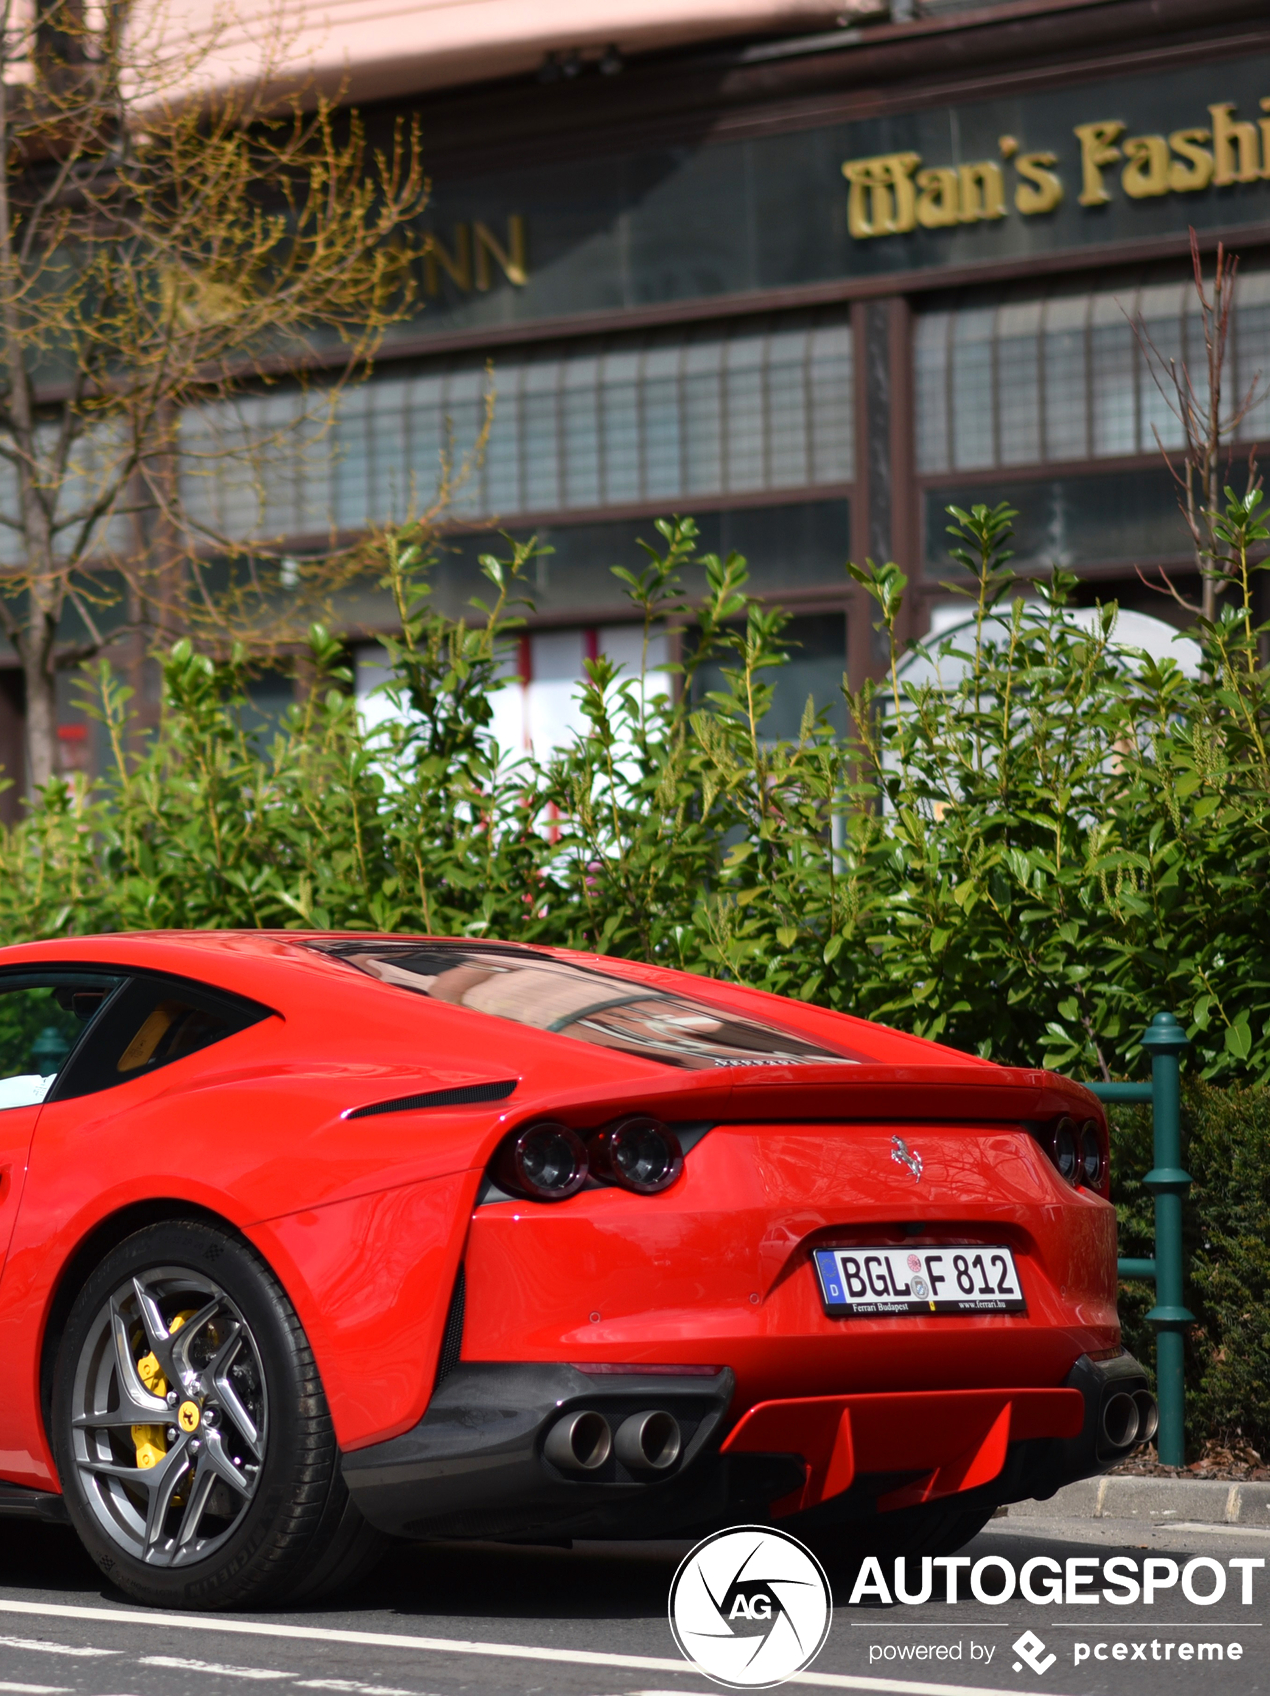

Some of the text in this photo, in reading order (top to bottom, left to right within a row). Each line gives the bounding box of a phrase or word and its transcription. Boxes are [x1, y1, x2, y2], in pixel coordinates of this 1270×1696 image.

[840, 1254, 1014, 1298] BGL F 812
[829, 1284, 839, 1297] D
[852, 1302, 909, 1312] Ferrari Budapest
[958, 1300, 1007, 1309] www.ferrari.hu
